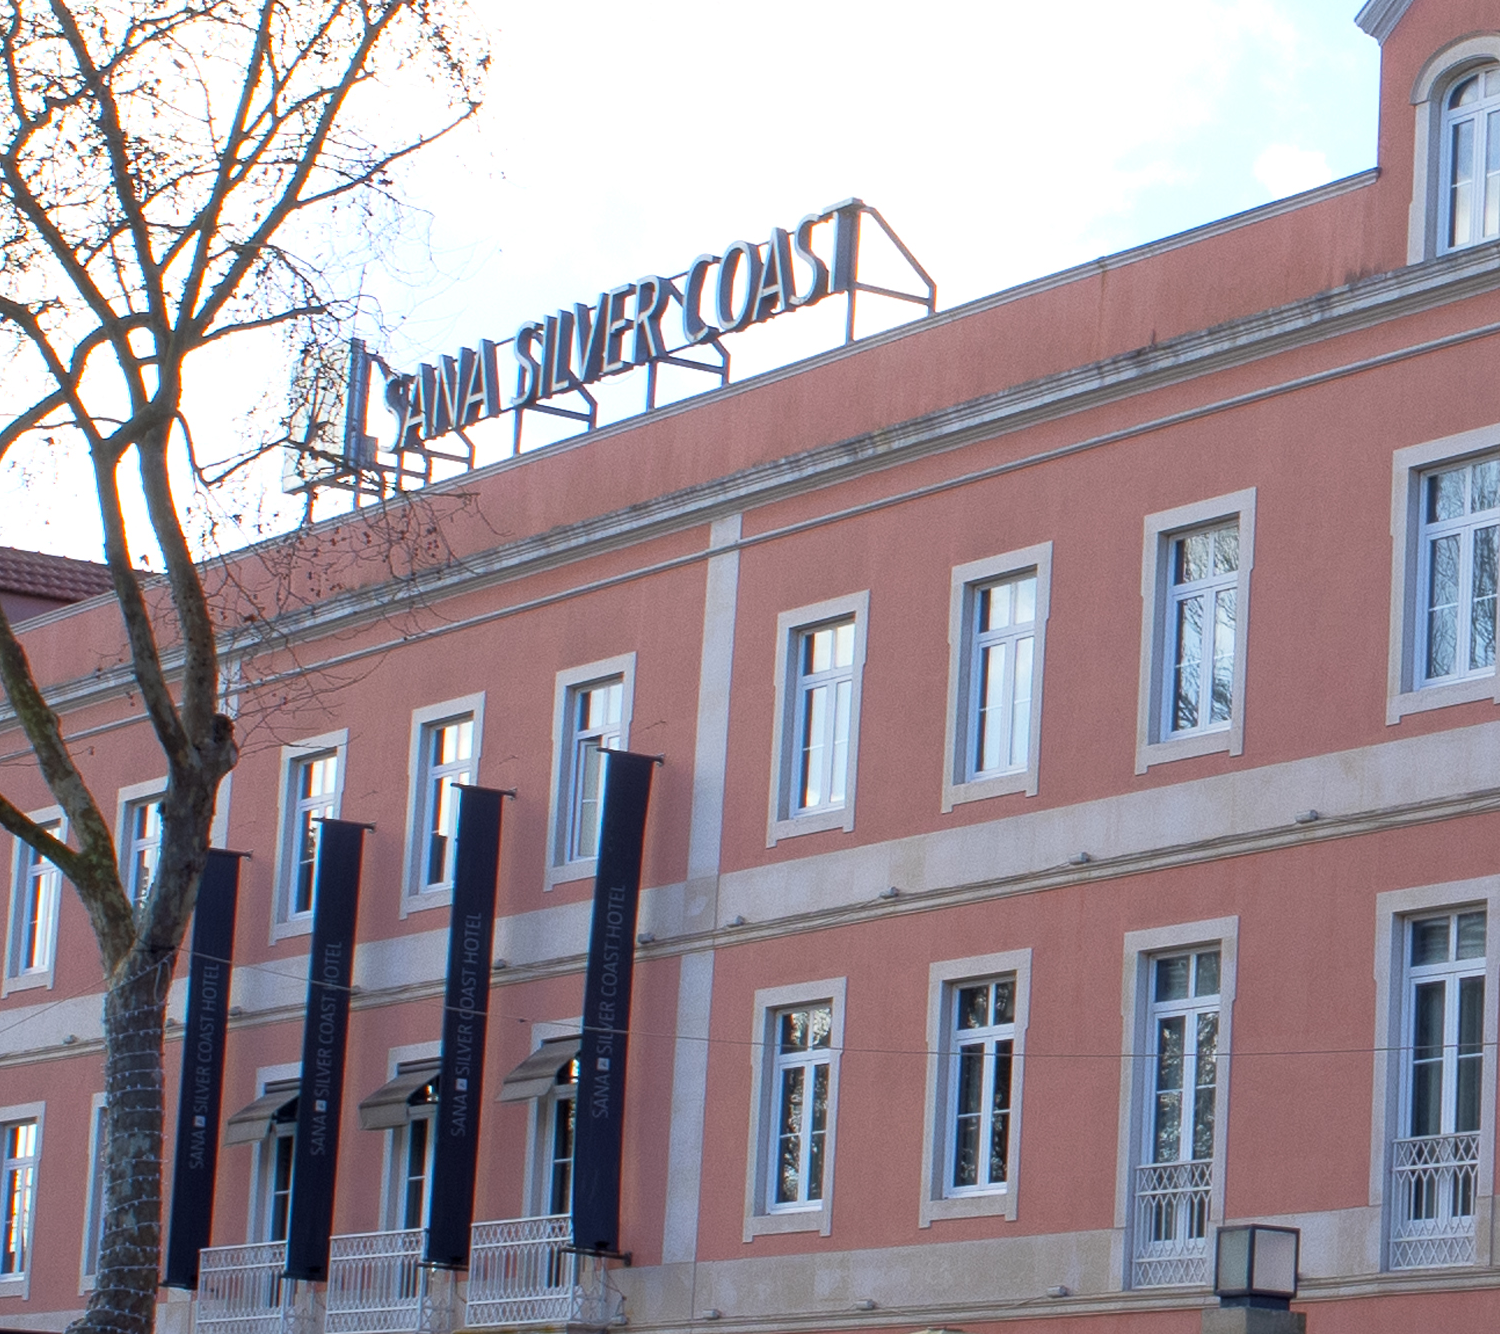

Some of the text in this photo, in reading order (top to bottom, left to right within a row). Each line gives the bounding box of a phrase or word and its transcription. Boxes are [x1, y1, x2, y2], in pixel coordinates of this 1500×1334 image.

[379, 197, 862, 452] SANA SILVER COAST
[189, 963, 220, 1170] SANA SILVER COAST HOTEL
[311, 942, 342, 1156] SANA SILVER COAST HOTEL
[450, 912, 482, 1137] SANA SILVER COAST HOTEL
[592, 884, 626, 1119] SANA SILVER COAST HOTEL
